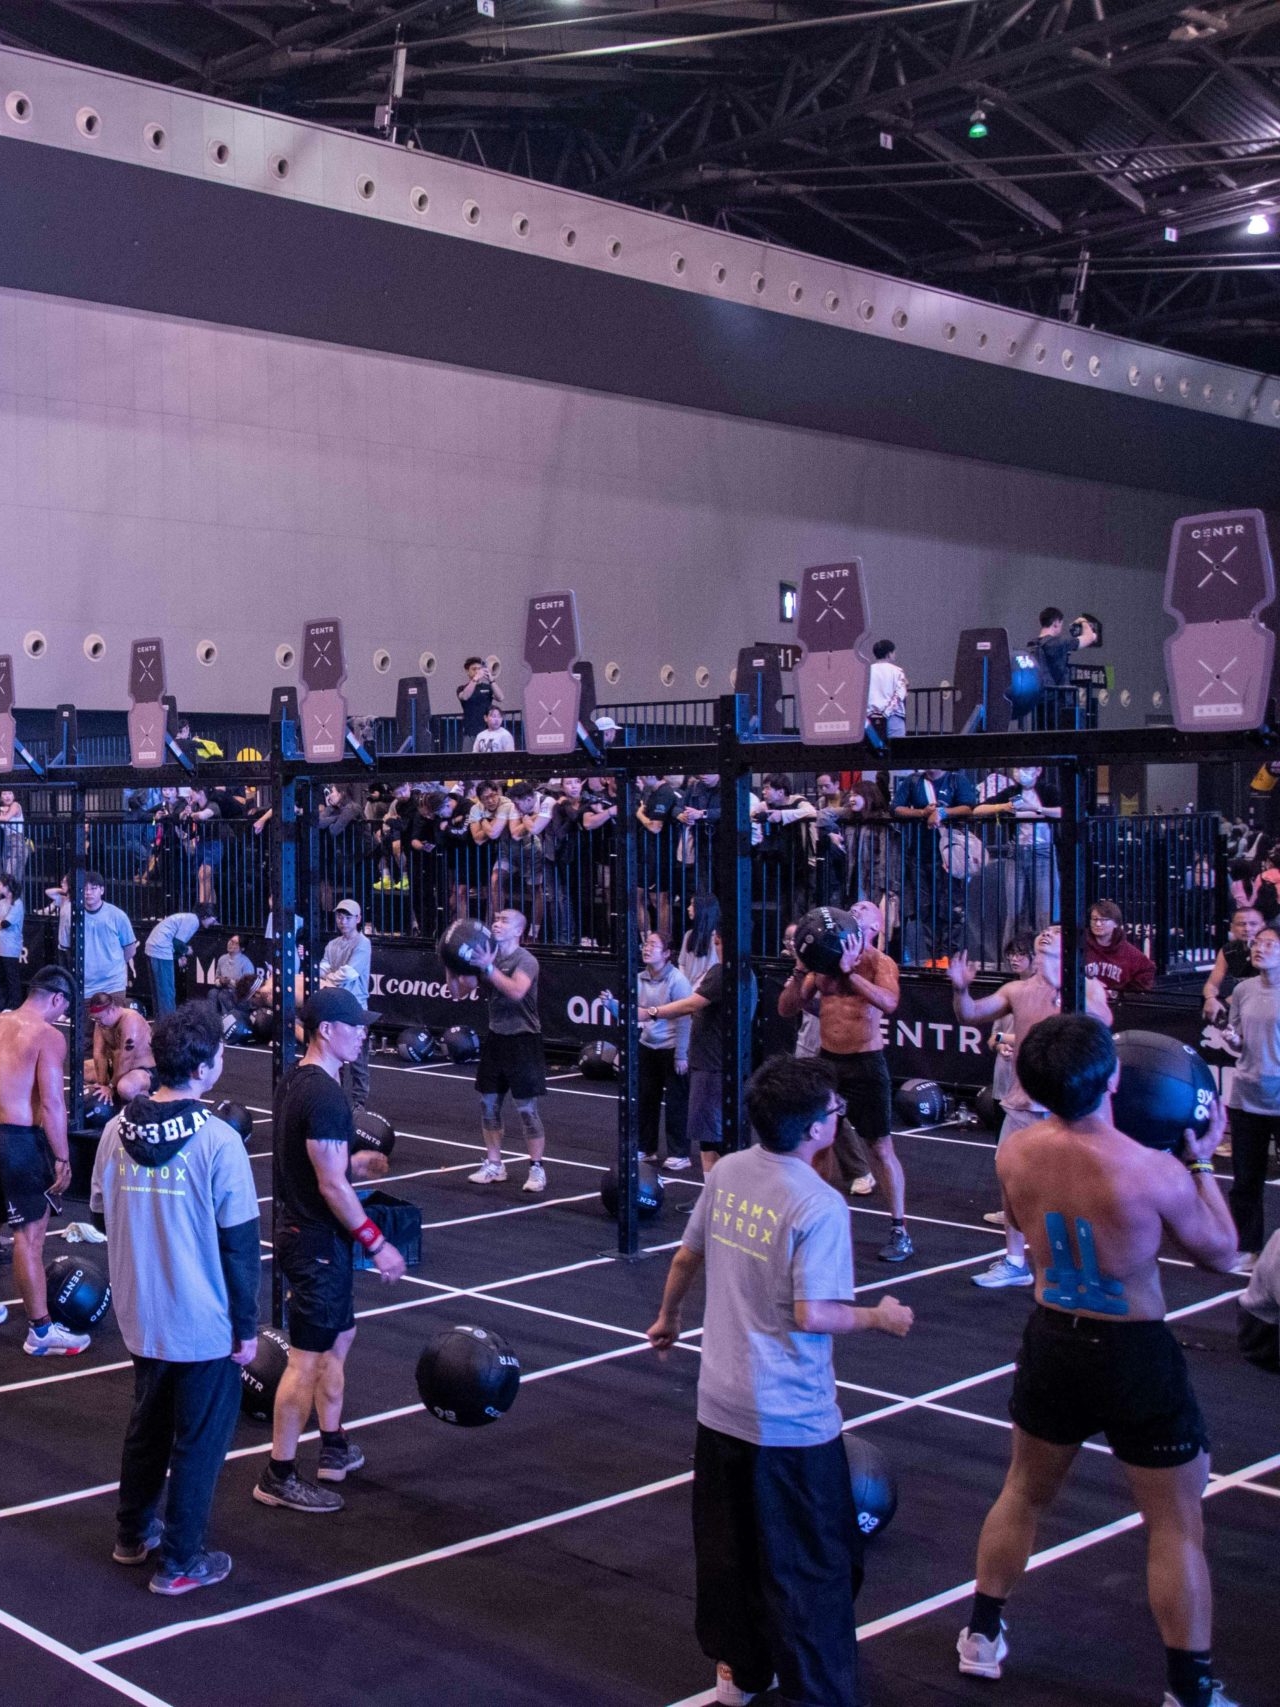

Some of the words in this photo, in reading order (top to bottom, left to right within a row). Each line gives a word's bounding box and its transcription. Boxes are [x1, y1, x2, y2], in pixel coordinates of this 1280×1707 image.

[1191, 524, 1245, 539] CENTR
[811, 568, 849, 581] CENTR
[535, 600, 565, 610] CENTR
[310, 626, 334, 635] CENTR
[137, 645, 156, 653] CENTR
[386, 978, 480, 1001] concet
[880, 1018, 982, 1054] ENTR
[356, 1129, 381, 1146] CENTR
[119, 1165, 186, 1181] HYROX
[639, 1195, 658, 1207] CEN
[716, 1188, 764, 1220] TEAM
[712, 1207, 773, 1245] HYROX
[58, 1269, 84, 1304] CENTR
[262, 1330, 290, 1357] ENTR
[241, 1366, 264, 1393] NTR
